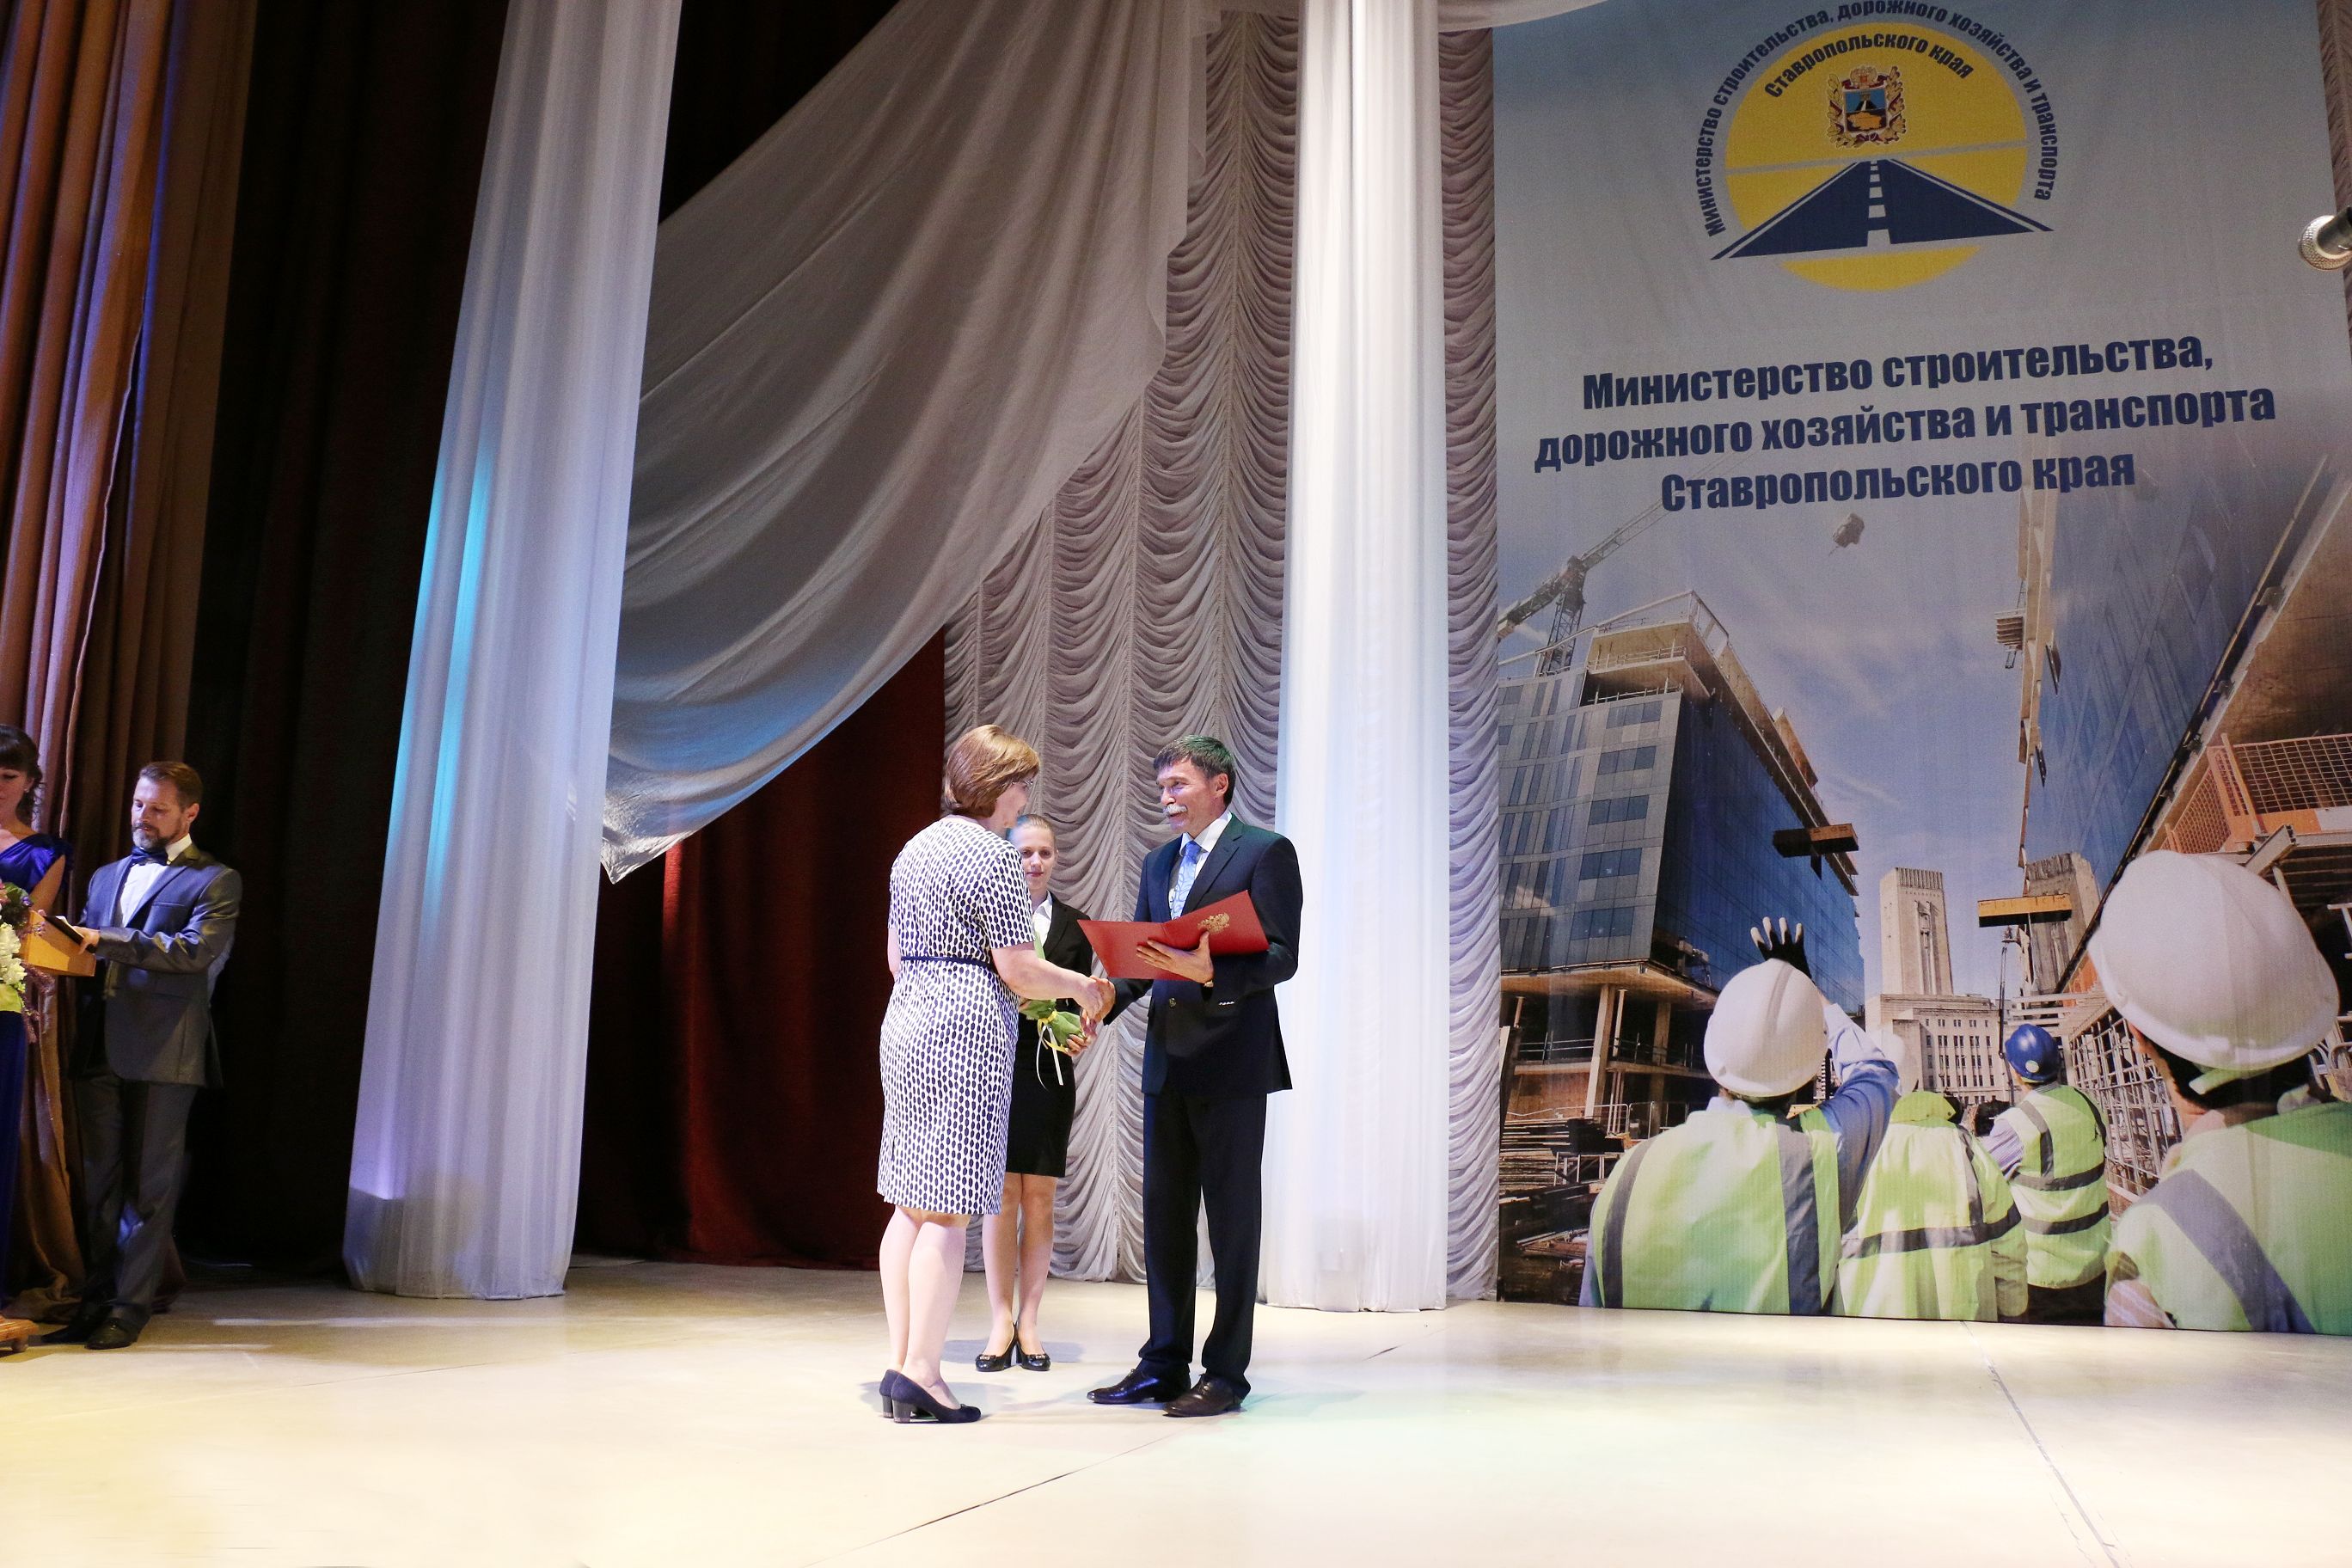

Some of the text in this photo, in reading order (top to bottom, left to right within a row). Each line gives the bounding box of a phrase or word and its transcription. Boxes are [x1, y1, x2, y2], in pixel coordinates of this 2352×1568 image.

[1765, 33, 1974, 98] Ставропольского края
[1696, 0, 2058, 236] Министерство строительства, дорожного хозяйства и транспорта
[1583, 335, 2213, 410] Министерство строительства,
[1534, 388, 2275, 474] дорожного хозяйства и транспорта
[1661, 453, 2135, 512] Ставропольского края
